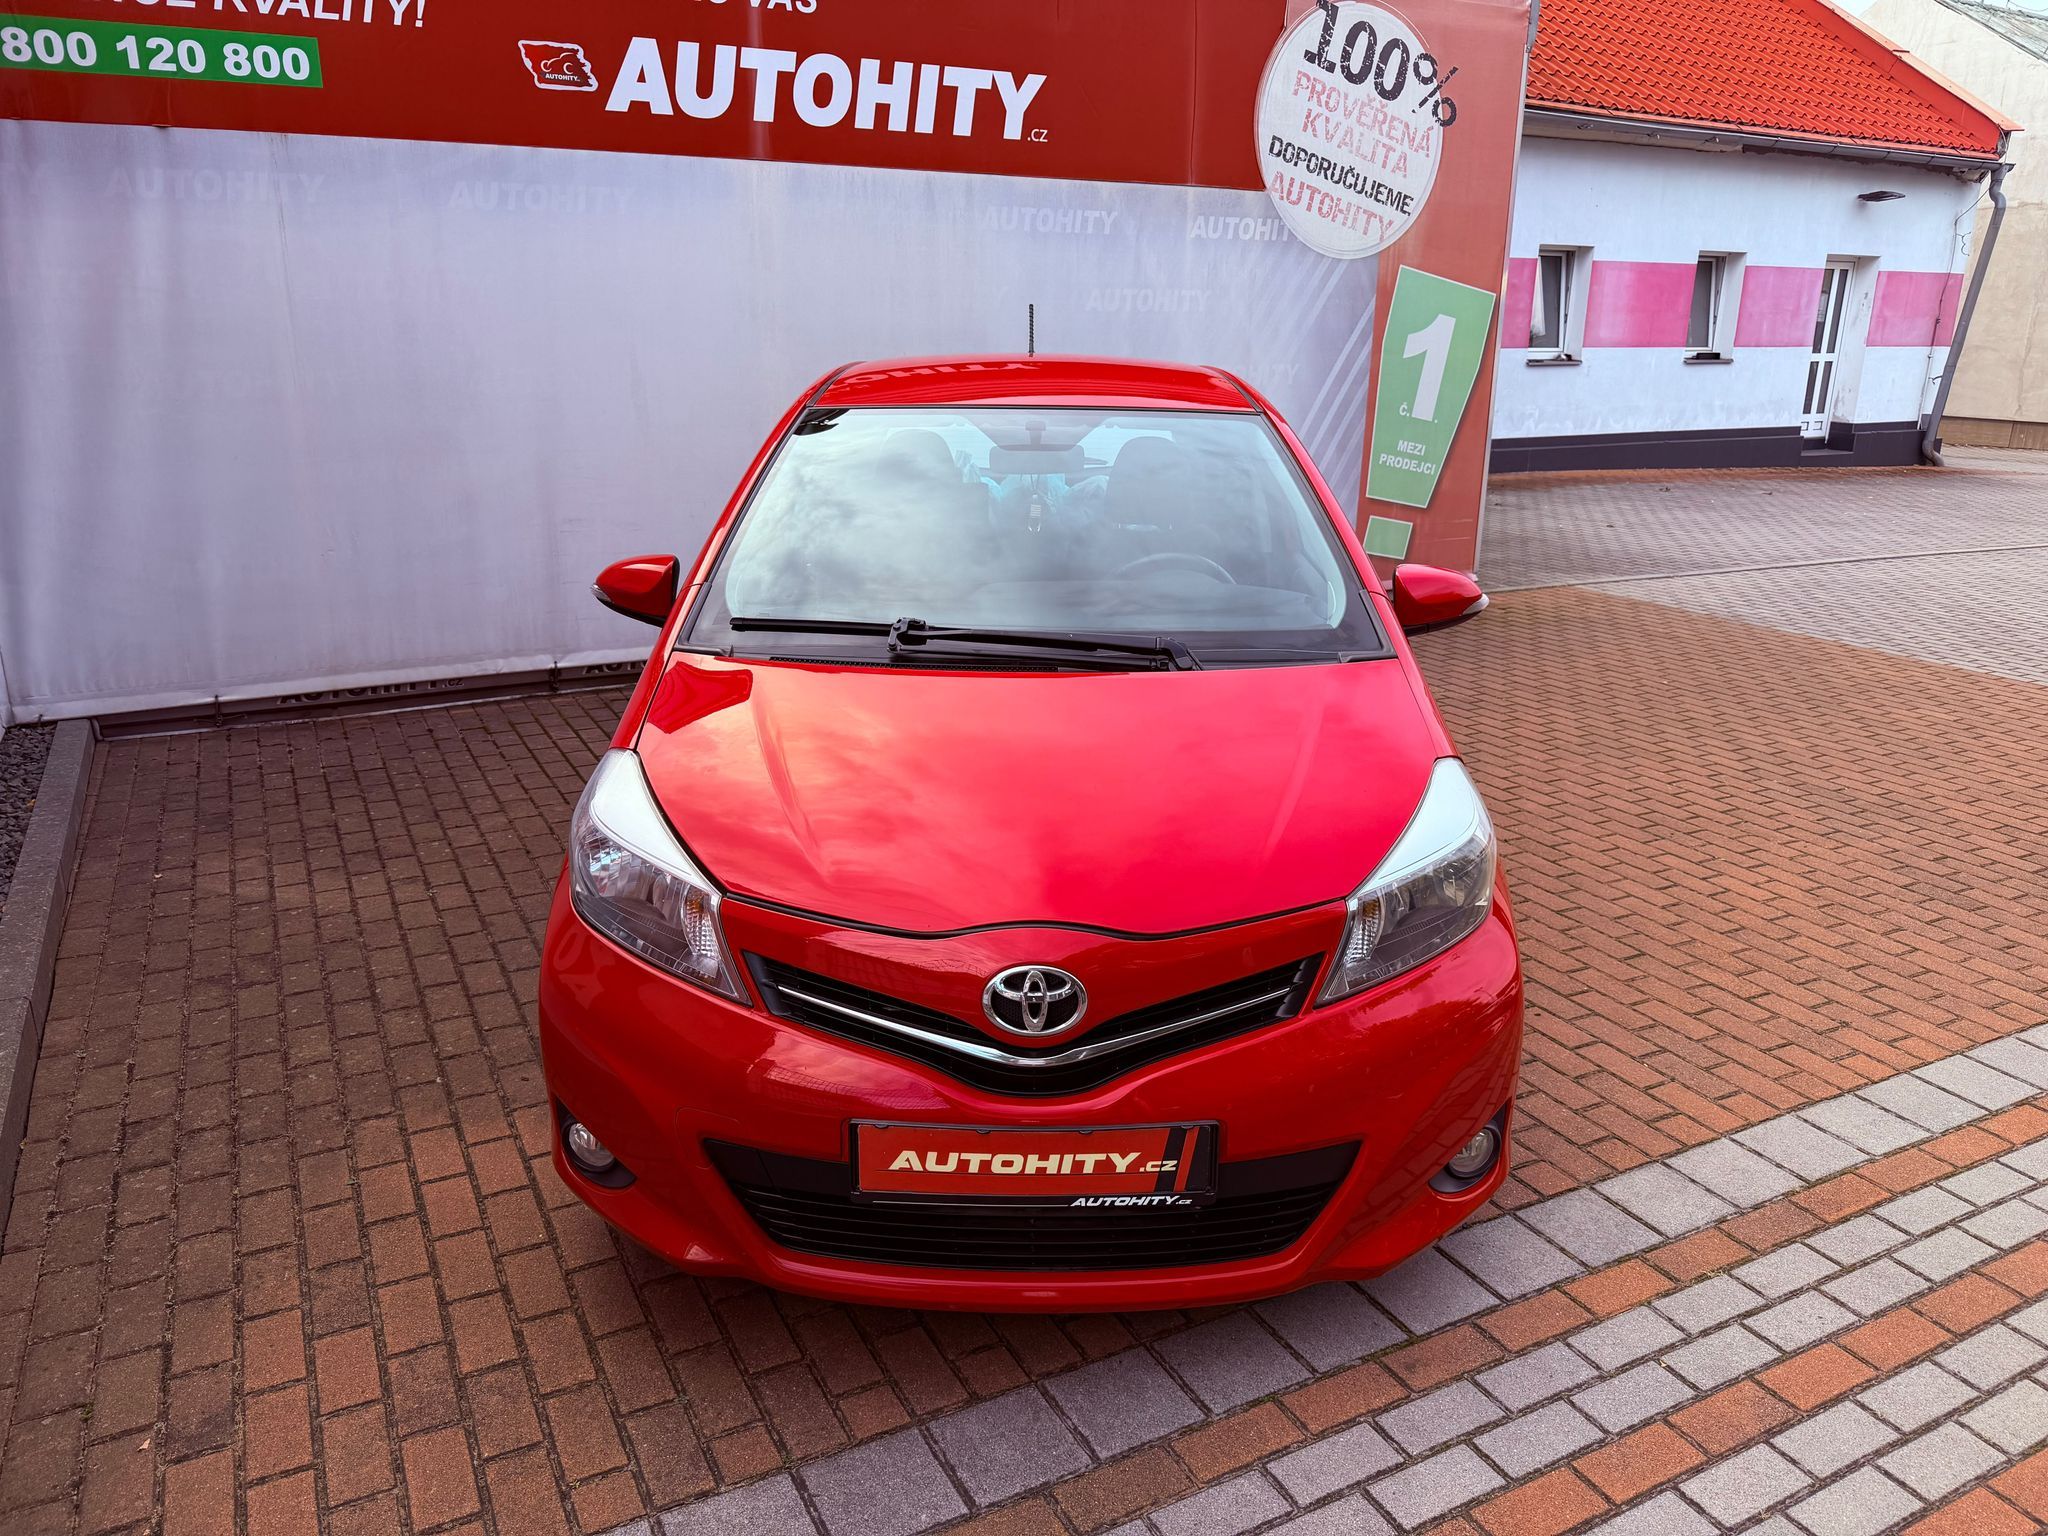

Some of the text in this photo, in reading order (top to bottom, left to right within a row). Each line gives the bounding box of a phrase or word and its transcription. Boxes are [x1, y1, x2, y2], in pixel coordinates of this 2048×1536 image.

[0, 26, 310, 80] 800 120 800
[1303, 0, 1459, 127] 100%
[1292, 70, 1434, 158] PROVĚŘENÁ
[1302, 108, 1408, 178] KVALITA
[1268, 135, 1414, 216] DOPORUČUJEME
[982, 205, 1118, 236] AUTOHITY
[1270, 171, 1394, 242] AUTOHITY
[1190, 215, 1290, 241] AUTOHIT
[1085, 287, 1211, 313] AUTOHITY
[1378, 453, 1436, 475] PRODEJCI
[1397, 439, 1425, 456] MEZI
[888, 1150, 1178, 1174] AUTOHITY.cz
